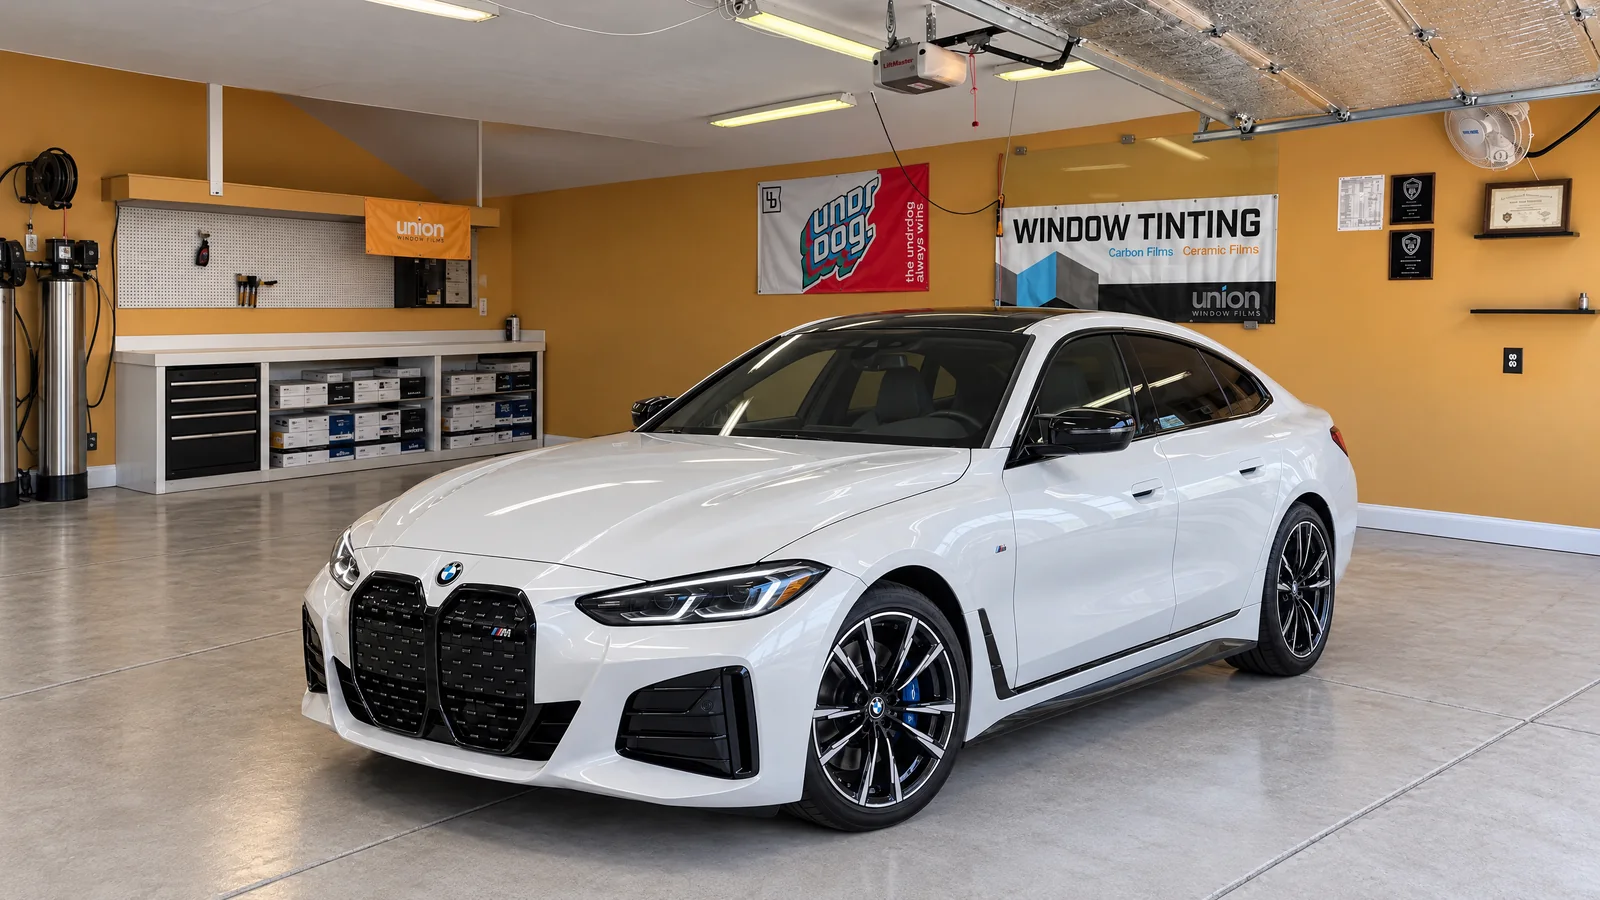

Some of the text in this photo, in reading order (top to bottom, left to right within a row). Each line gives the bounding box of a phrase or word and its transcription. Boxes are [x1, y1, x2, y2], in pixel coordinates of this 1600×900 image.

[883, 58, 914, 68] LiftMaster
[397, 216, 444, 237] union
[1013, 208, 1261, 244] WINDOW TINTING
[905, 201, 916, 283] the undrdog
[1108, 244, 1259, 258] Carbon Films Ceramic Films
[915, 238, 926, 283] always
[1192, 285, 1259, 310] union
